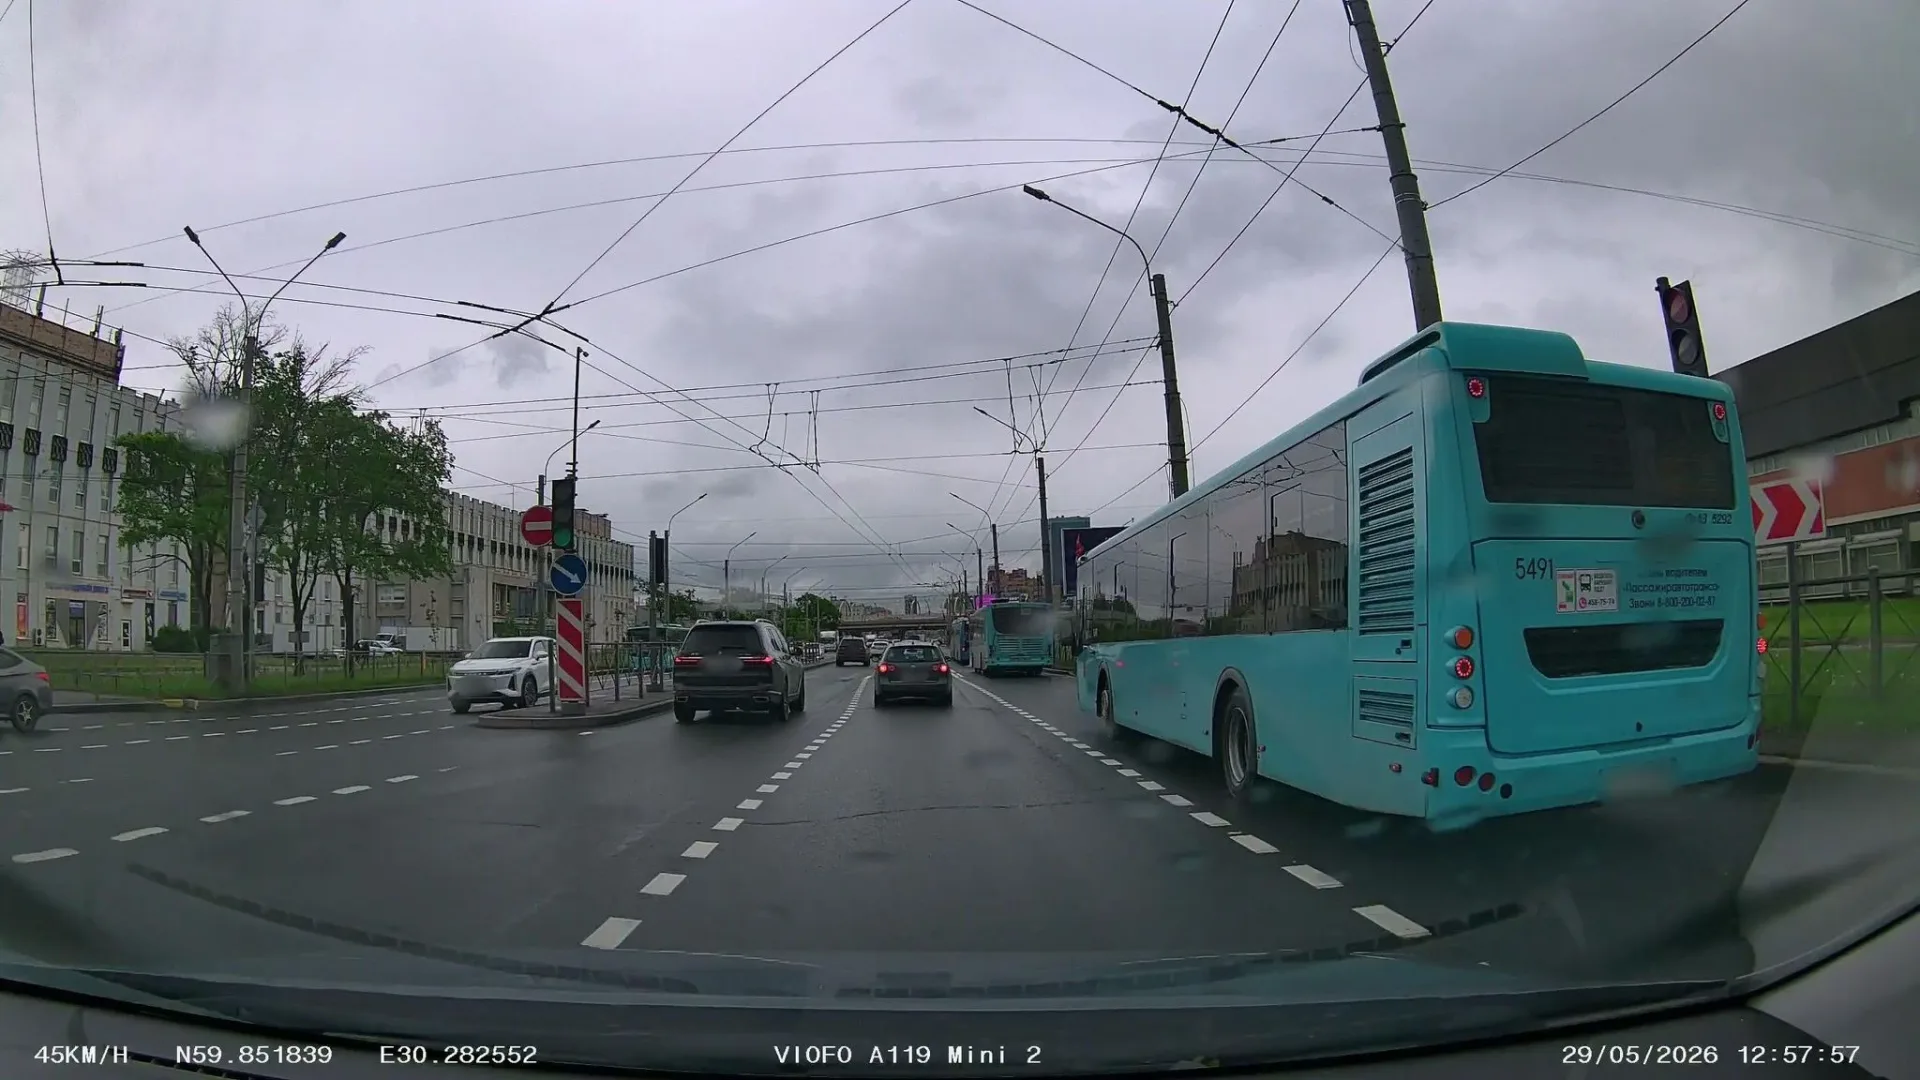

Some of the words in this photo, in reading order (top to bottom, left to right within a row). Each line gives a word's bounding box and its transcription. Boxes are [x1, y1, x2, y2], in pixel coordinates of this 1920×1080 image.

[1712, 513, 1732, 524] 5292
[1515, 557, 1553, 580] 5491
[1629, 598, 1655, 608] Звони
